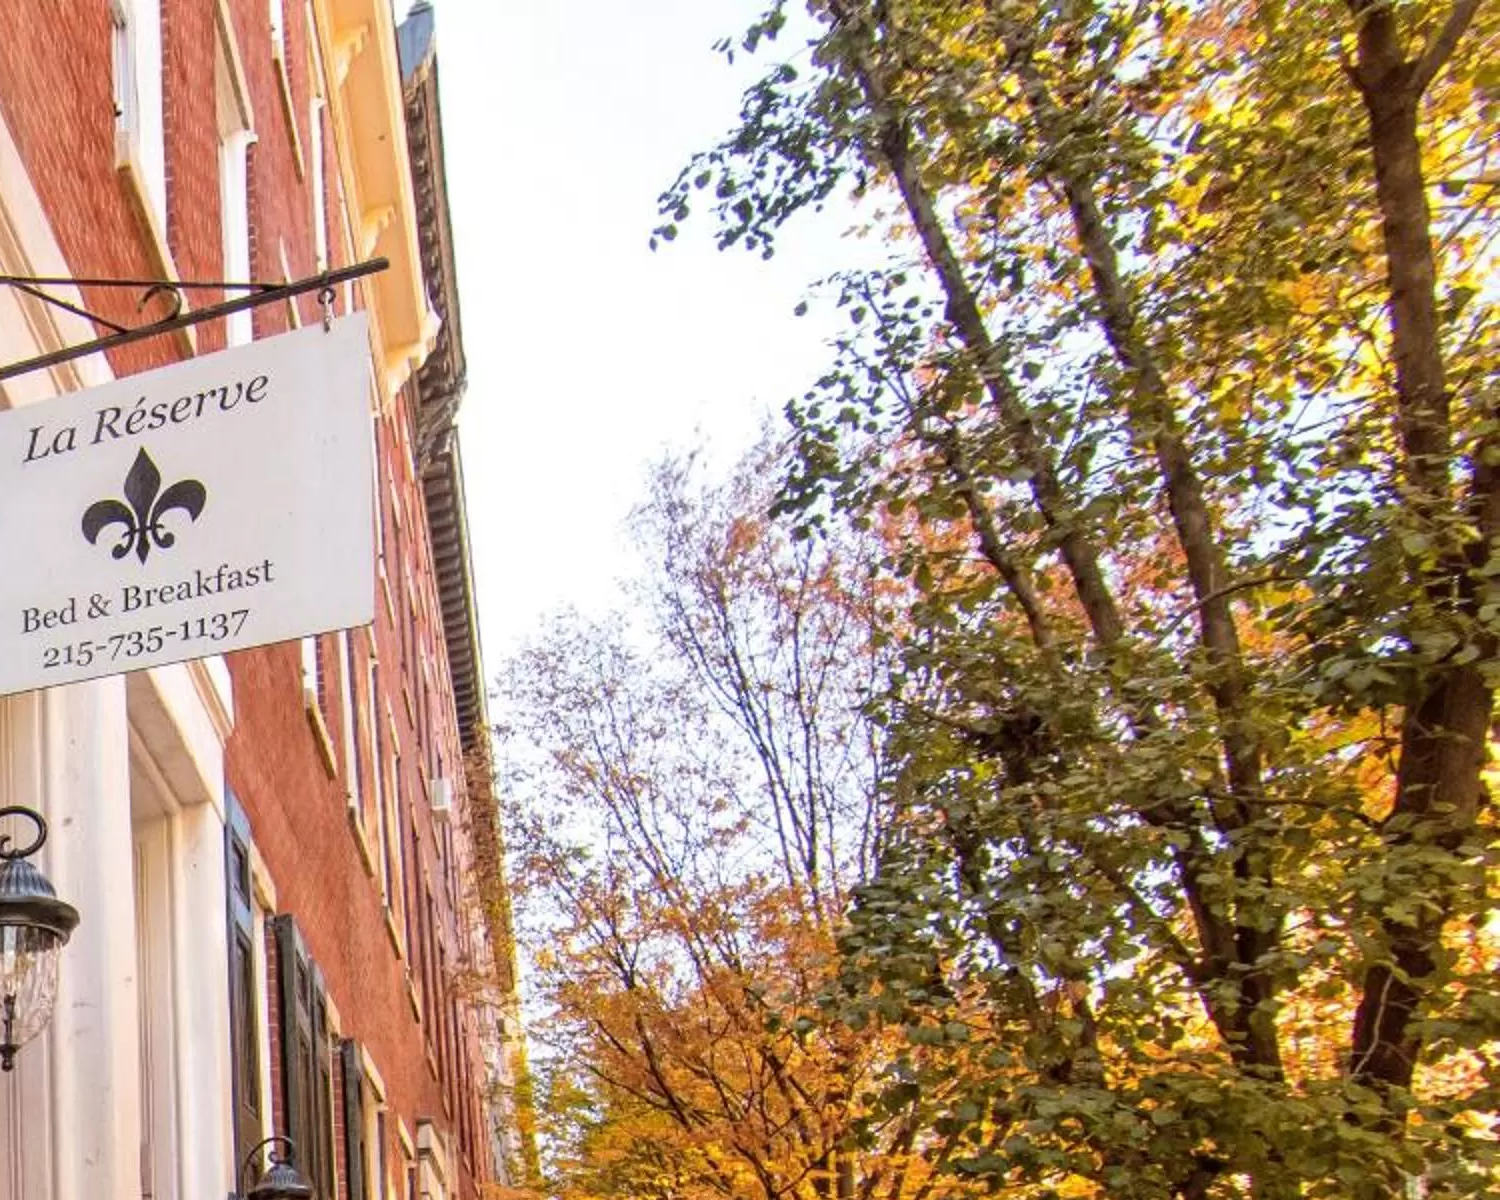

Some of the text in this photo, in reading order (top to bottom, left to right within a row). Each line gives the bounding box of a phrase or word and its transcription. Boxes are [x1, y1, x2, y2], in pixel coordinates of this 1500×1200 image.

[23, 374, 269, 463] La Réserve
[21, 558, 275, 635] Bed & Breakfast
[43, 609, 249, 669] 215-735-1137
